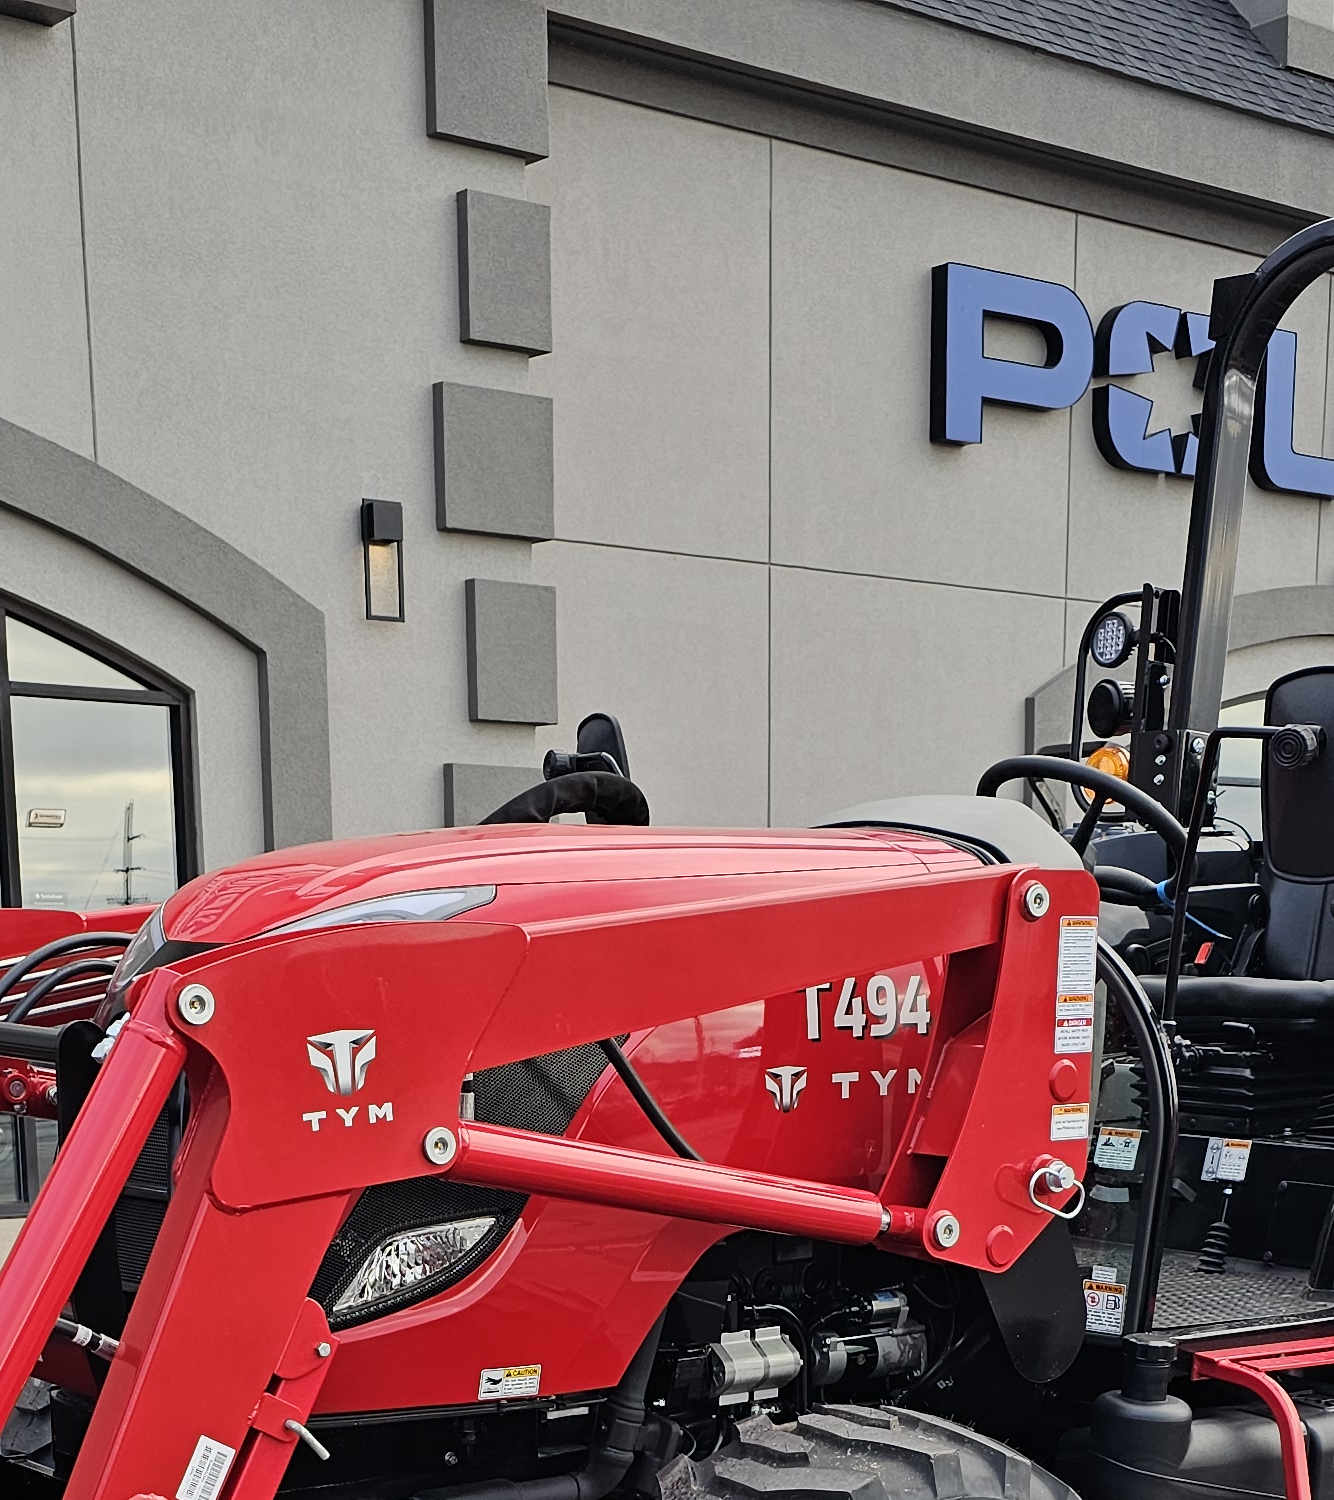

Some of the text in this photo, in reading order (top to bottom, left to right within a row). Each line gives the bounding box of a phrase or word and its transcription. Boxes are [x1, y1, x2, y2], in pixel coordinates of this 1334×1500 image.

[803, 975, 931, 1041] T494
[302, 1101, 394, 1132] TYM
[1095, 1284, 1123, 1294] WARNING
[512, 1368, 538, 1377] CAUTION
